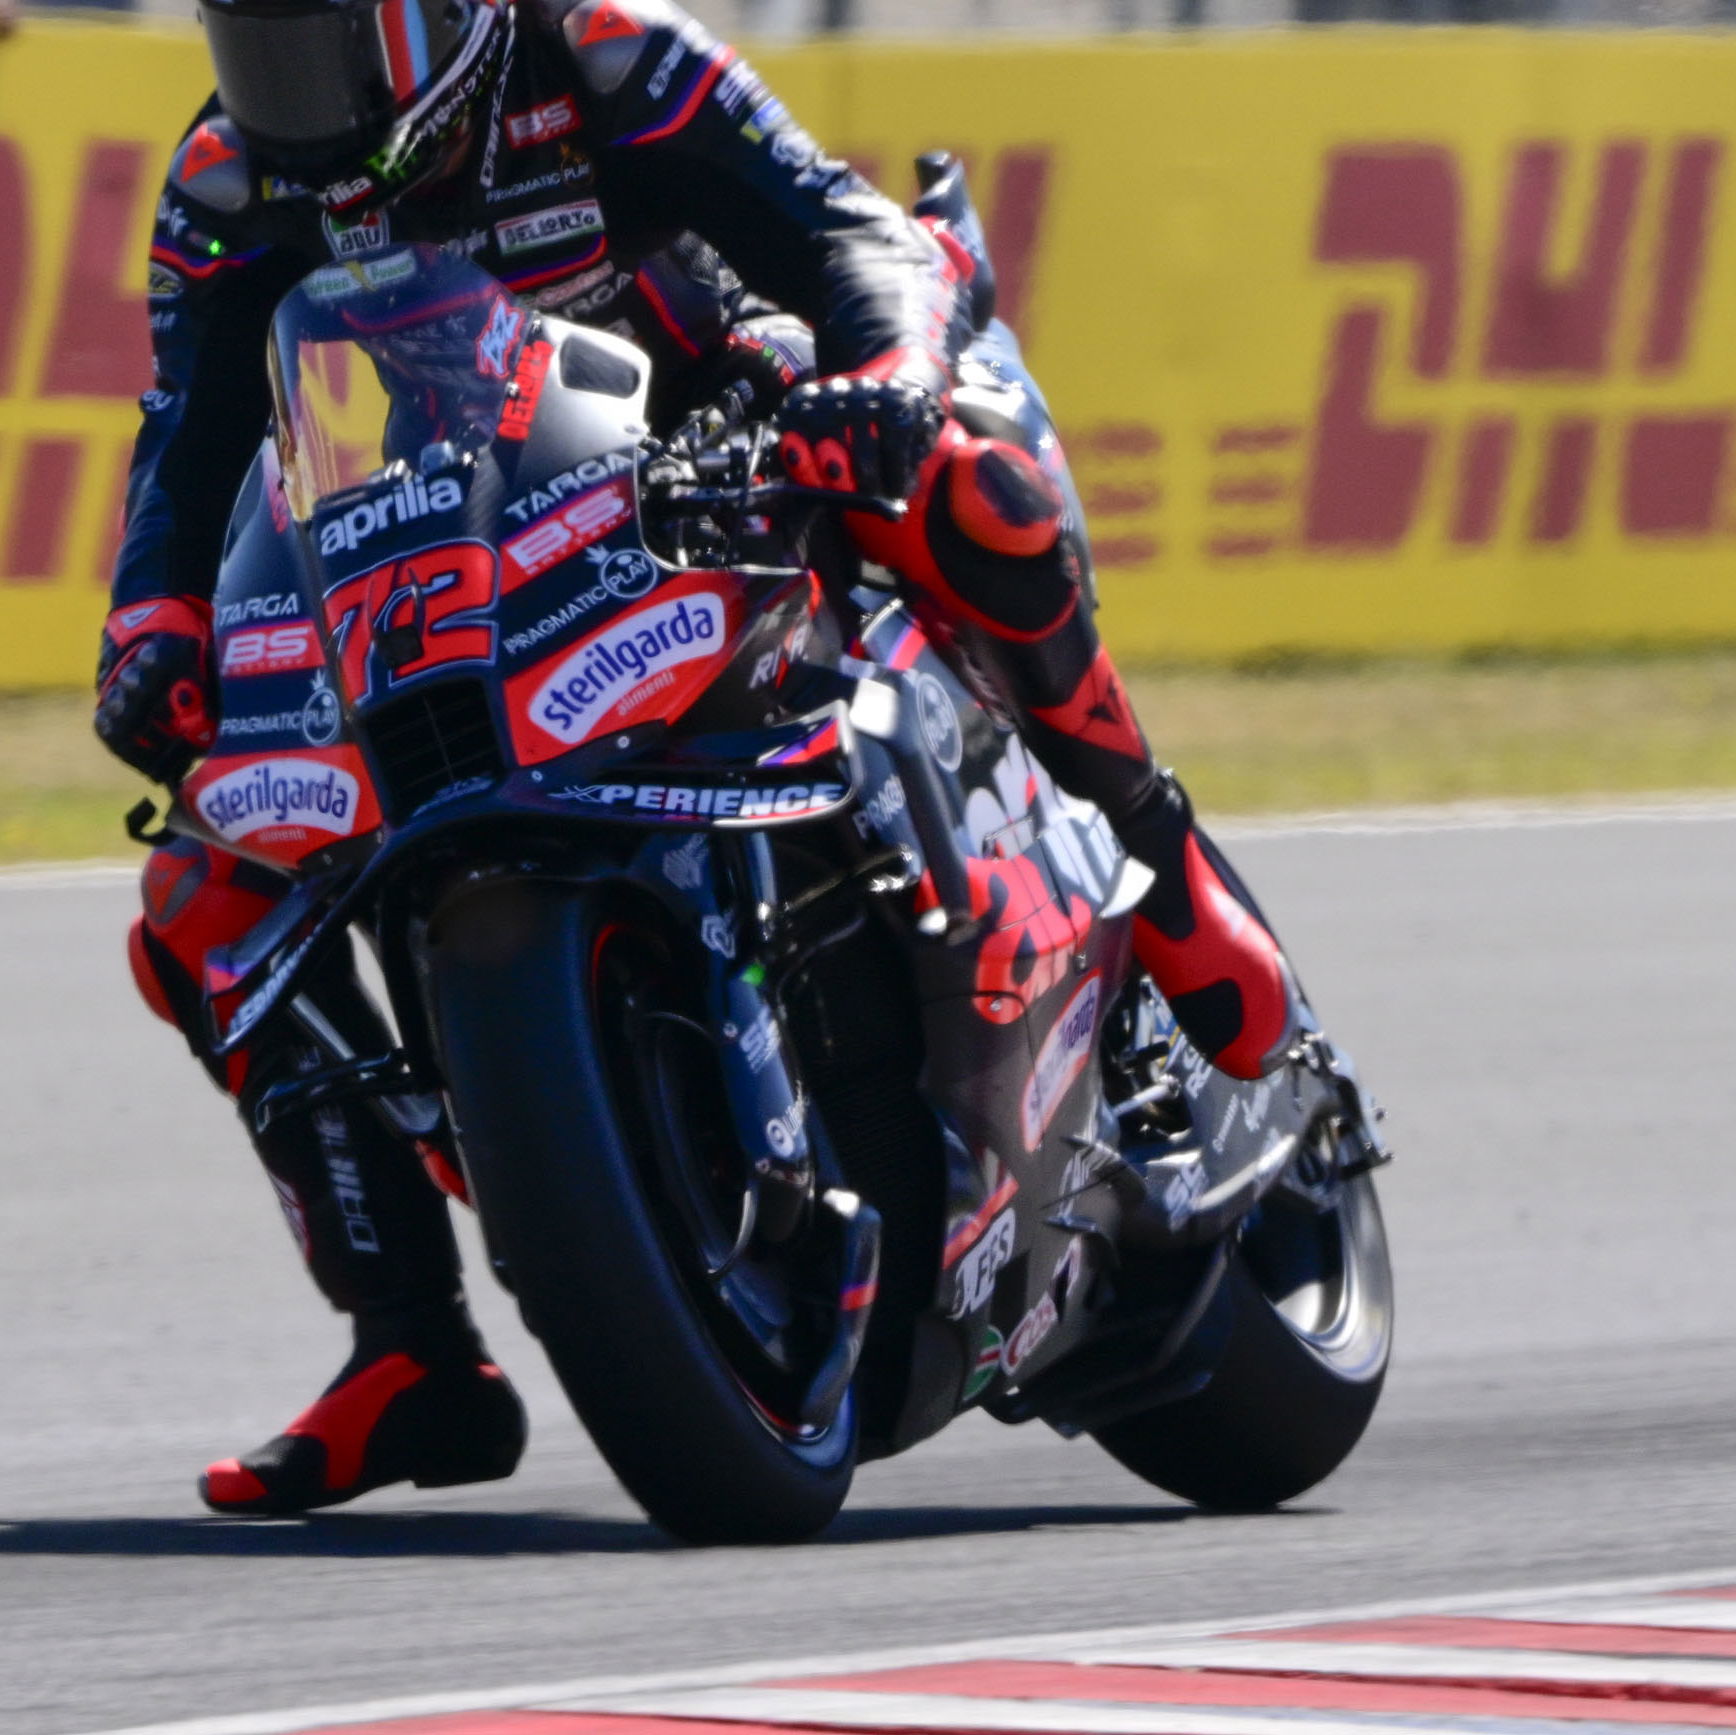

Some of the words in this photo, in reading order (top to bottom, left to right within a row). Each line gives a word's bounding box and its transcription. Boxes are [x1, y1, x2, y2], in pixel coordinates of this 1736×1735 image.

[510, 100, 573, 135] BS
[318, 175, 373, 205] rilia
[1303, 135, 1736, 548] DHL
[320, 475, 464, 557] aprilia
[504, 451, 635, 523] TARGA
[508, 485, 626, 568] BS
[219, 592, 299, 626] TARGA
[322, 540, 498, 707] 72
[503, 586, 607, 655] PRAGMATIC
[606, 557, 651, 590] PLAY
[224, 626, 310, 664] BS
[542, 600, 715, 731] sterilgarda
[220, 711, 301, 736] PRAGMATIC
[304, 709, 337, 727] PLAY
[617, 671, 676, 716] alimenti
[205, 765, 350, 830] sterilgarda
[547, 782, 847, 817] XPERIENCE
